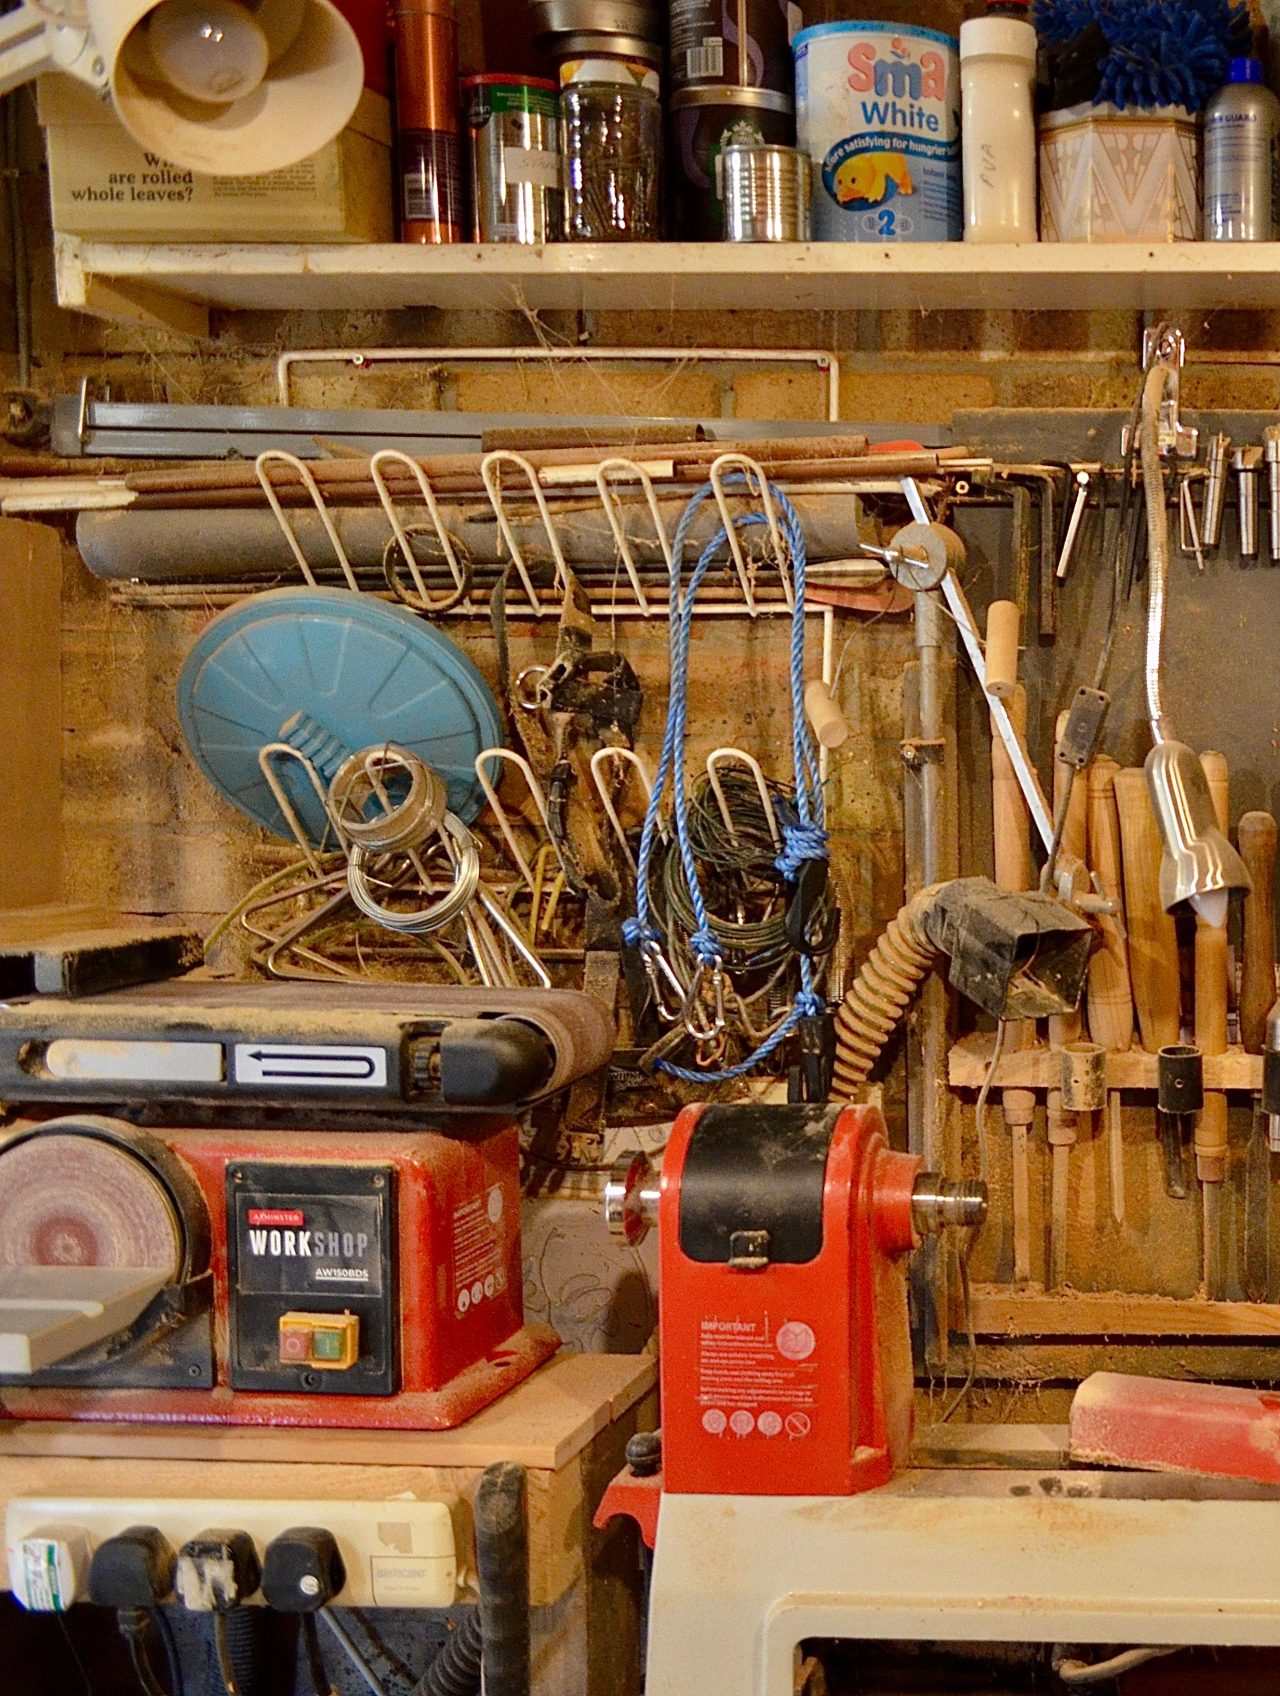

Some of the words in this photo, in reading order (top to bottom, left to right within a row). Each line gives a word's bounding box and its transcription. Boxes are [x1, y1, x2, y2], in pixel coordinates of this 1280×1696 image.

[861, 101, 939, 132] White
[844, 136, 891, 152] satisfying
[892, 137, 909, 149] for
[980, 143, 996, 188] PVA
[108, 172, 136, 185] are
[142, 171, 193, 185] rolled
[71, 187, 125, 201] whole
[131, 187, 193, 202] leaves?
[878, 209, 896, 235] 2
[249, 1229, 368, 1257] WORKSHOP
[701, 1321, 756, 1332] IMPORTANT
